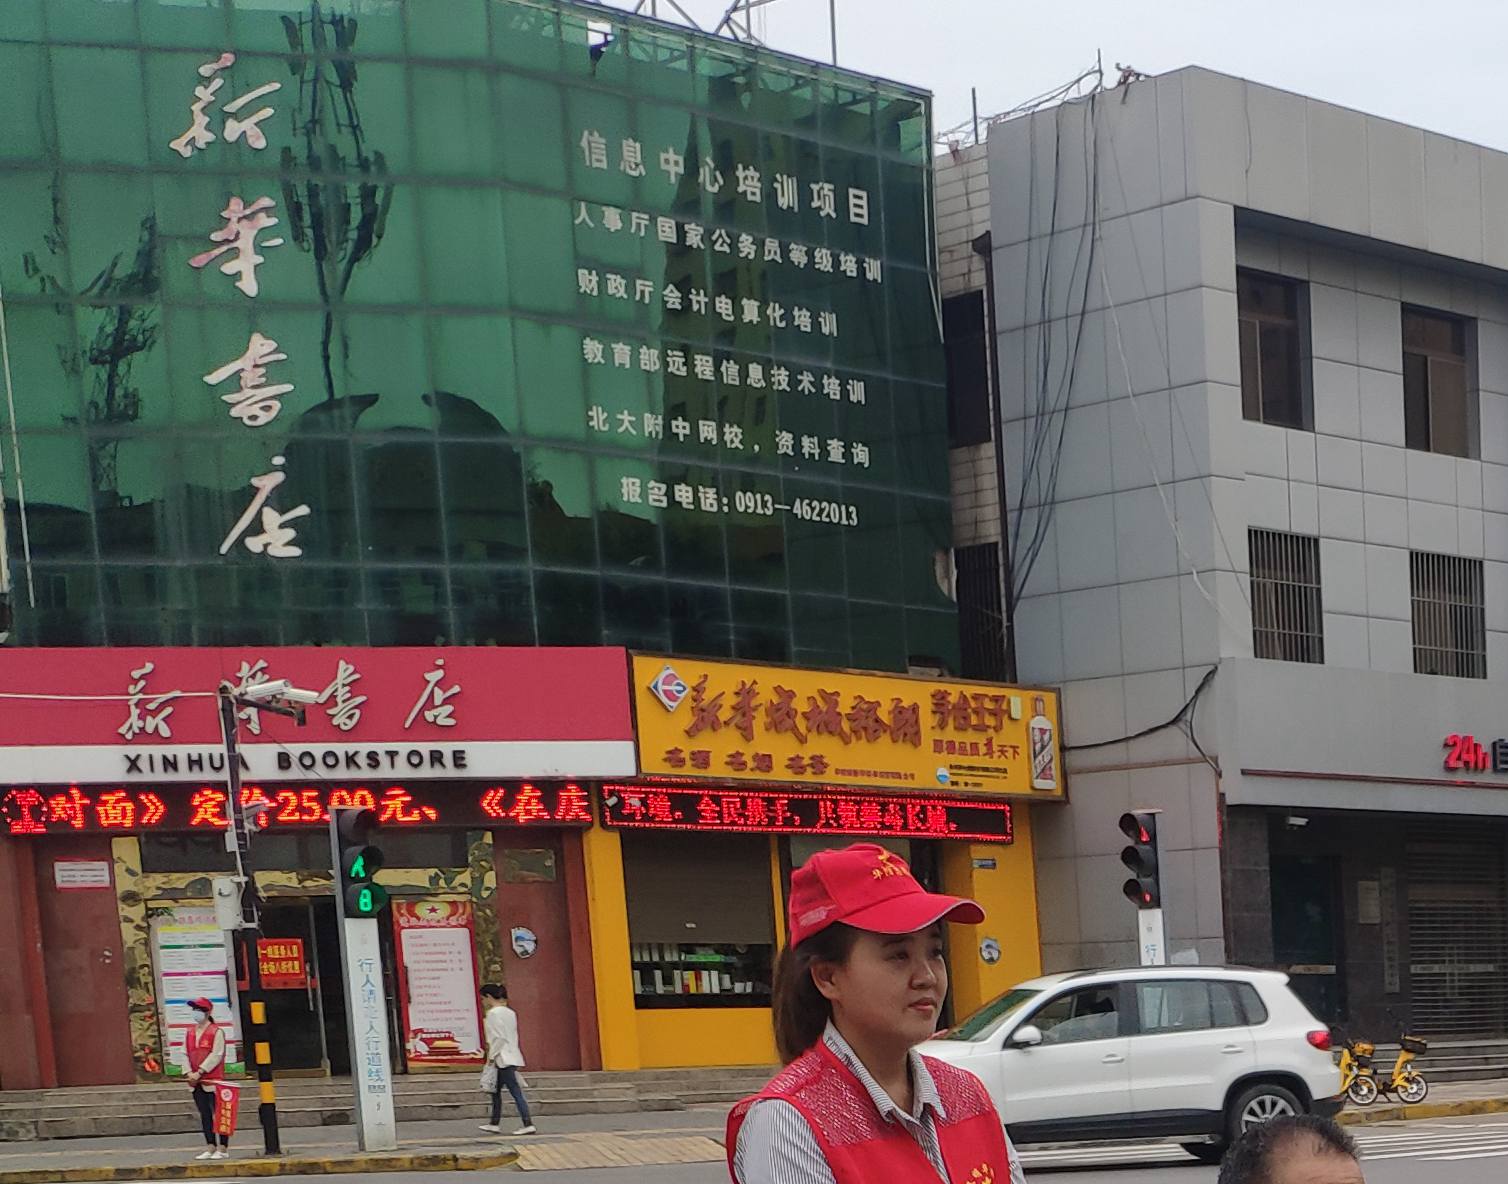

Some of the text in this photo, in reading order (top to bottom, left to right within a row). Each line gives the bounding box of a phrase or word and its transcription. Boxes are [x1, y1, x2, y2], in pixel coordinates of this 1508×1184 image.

[580, 129, 870, 226] 信息中心培训项目
[574, 201, 882, 284] 人事厅国家公务员等级培训
[577, 268, 839, 337] 财政厅会计电算化培训
[582, 336, 866, 406] 教育部远程信息技术培训
[587, 406, 871, 468] 北大附中网校，资料查询
[277, 749, 469, 771] BOOKSTORE
